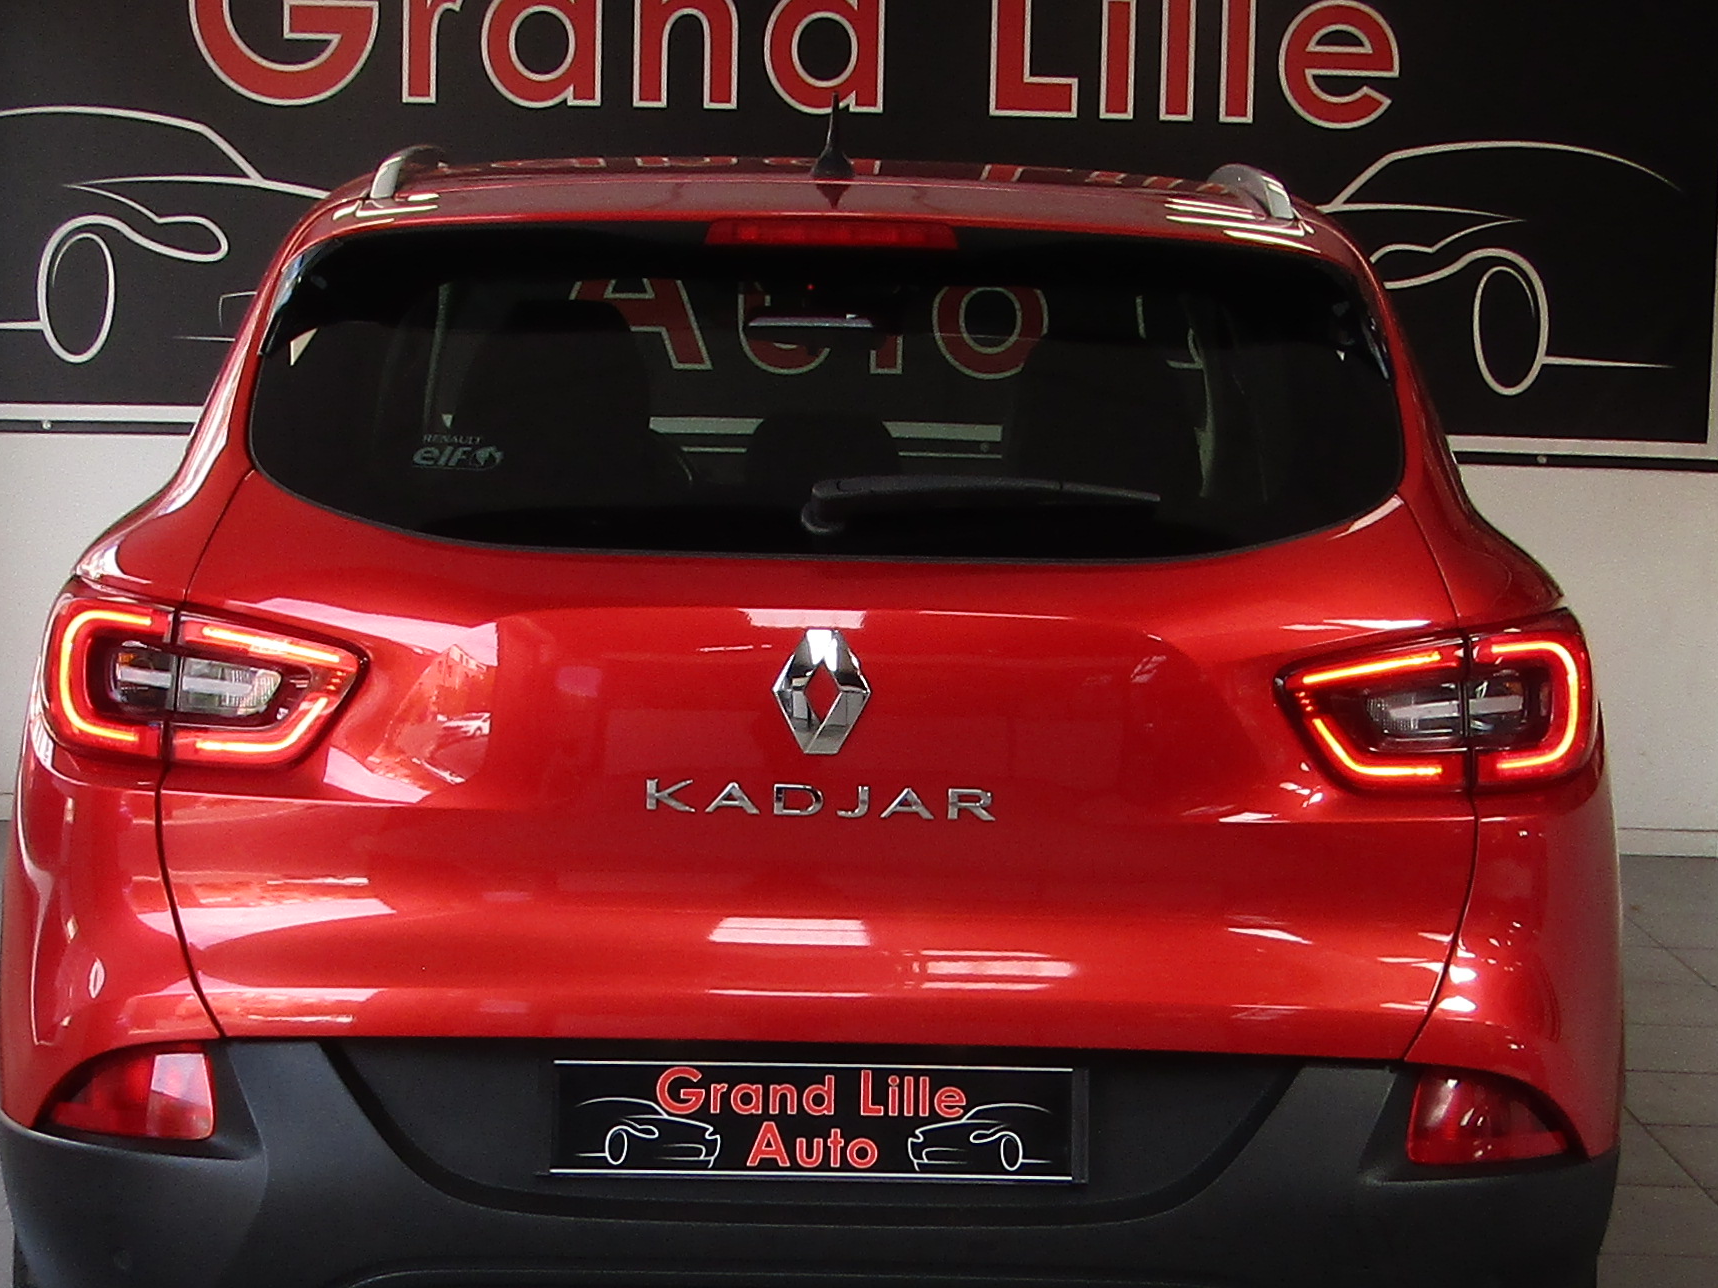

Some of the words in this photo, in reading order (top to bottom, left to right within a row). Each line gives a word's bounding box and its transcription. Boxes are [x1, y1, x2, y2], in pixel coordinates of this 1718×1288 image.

[422, 433, 481, 445] RENAULT
[646, 778, 996, 821] KADJAR
[655, 1066, 835, 1116] Grand
[859, 1069, 968, 1119] Lille
[747, 1121, 879, 1169] Auto
